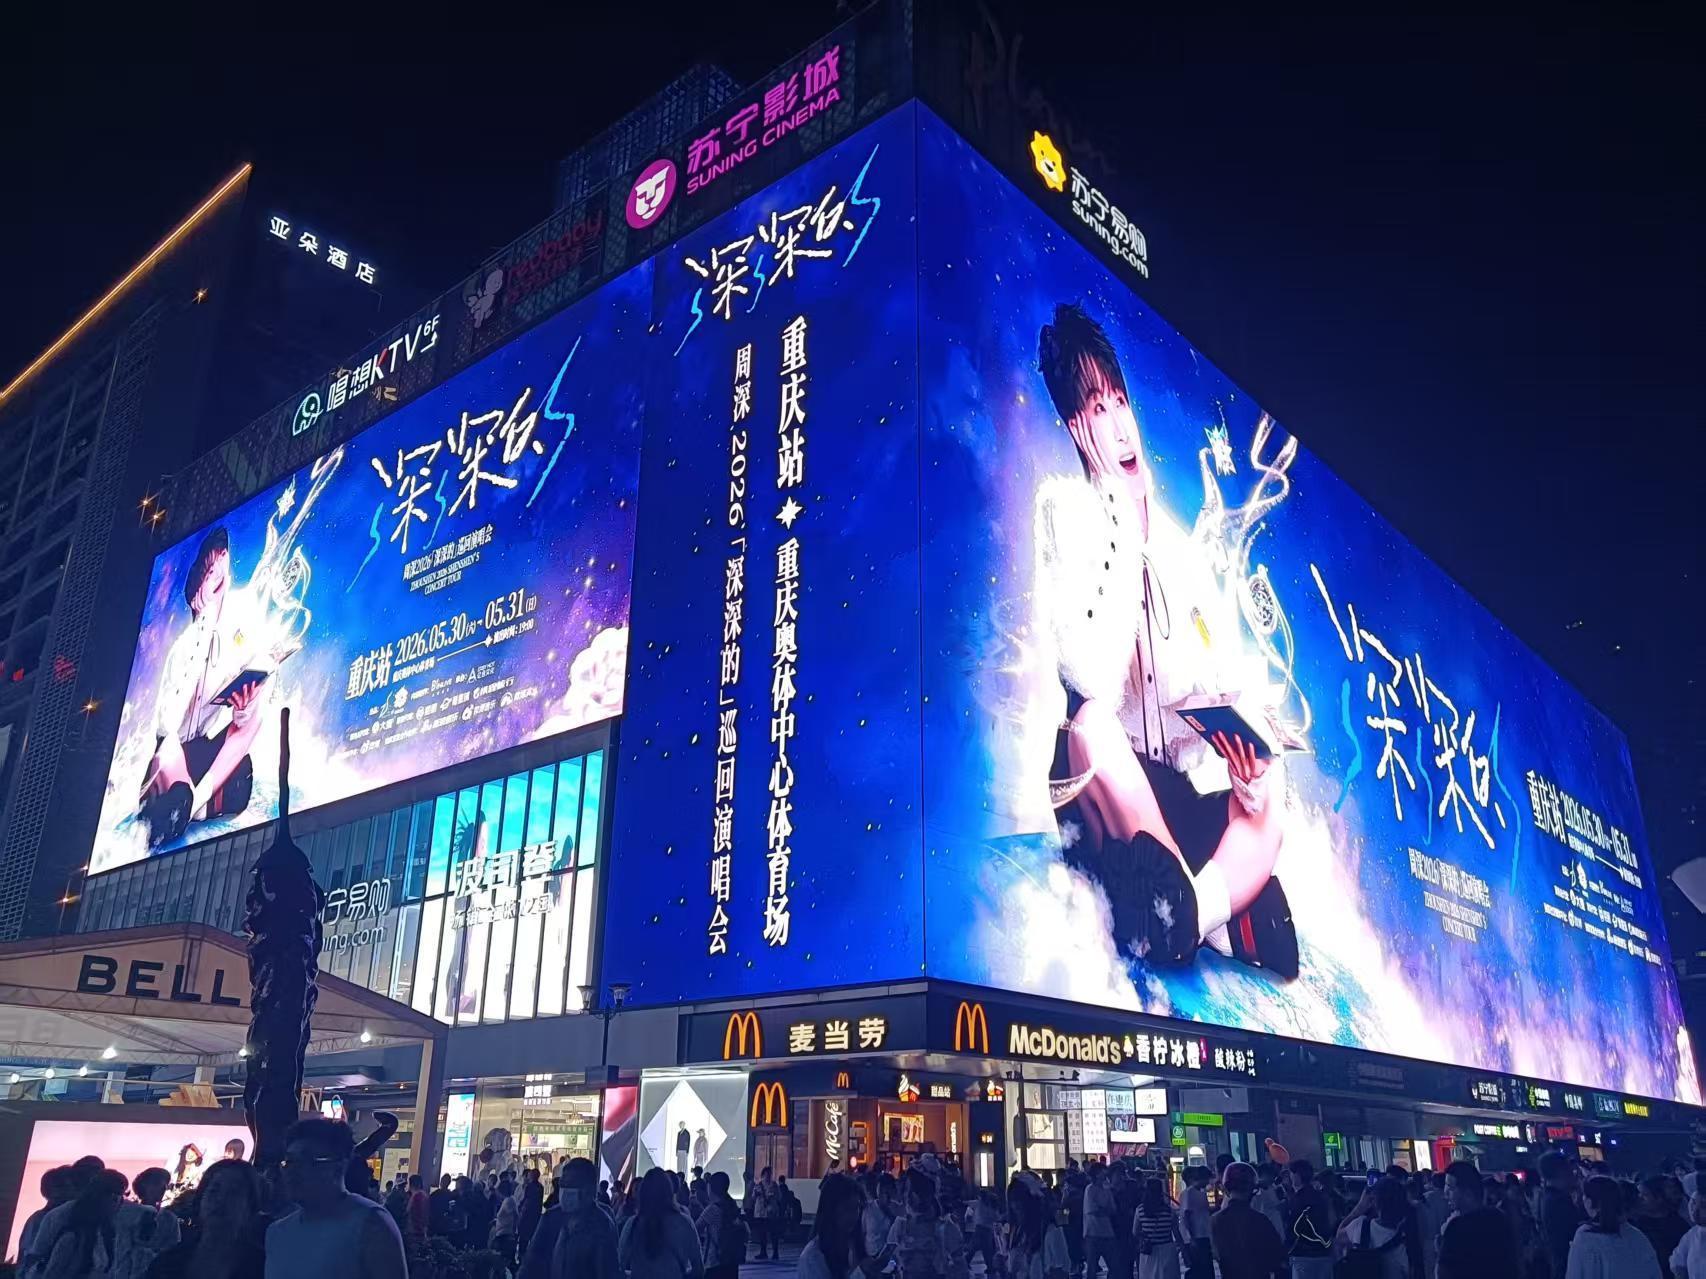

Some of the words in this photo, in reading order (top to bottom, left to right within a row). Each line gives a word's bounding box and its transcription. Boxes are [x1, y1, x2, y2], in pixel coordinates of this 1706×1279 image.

[687, 45, 840, 174] 苏宁影城
[687, 141, 757, 195] SUNING
[763, 87, 840, 147] CINEMA
[1071, 166, 1147, 261] 苏宁易购
[1072, 200, 1149, 279] suning.com
[270, 216, 376, 284] 亚朵酒店
[423, 314, 440, 337] 6F
[777, 315, 807, 488] 重庆站
[345, 643, 393, 700] 重庆站
[763, 537, 800, 947] 重庆奥体中心体育场
[454, 840, 556, 899] 波司登
[77, 954, 241, 1008] BELL
[789, 1016, 887, 1053] 麦当劳
[1009, 1024, 1121, 1065] McDonald's
[930, 1085, 951, 1098] 甜品站
[825, 1100, 840, 1160] McCafé
